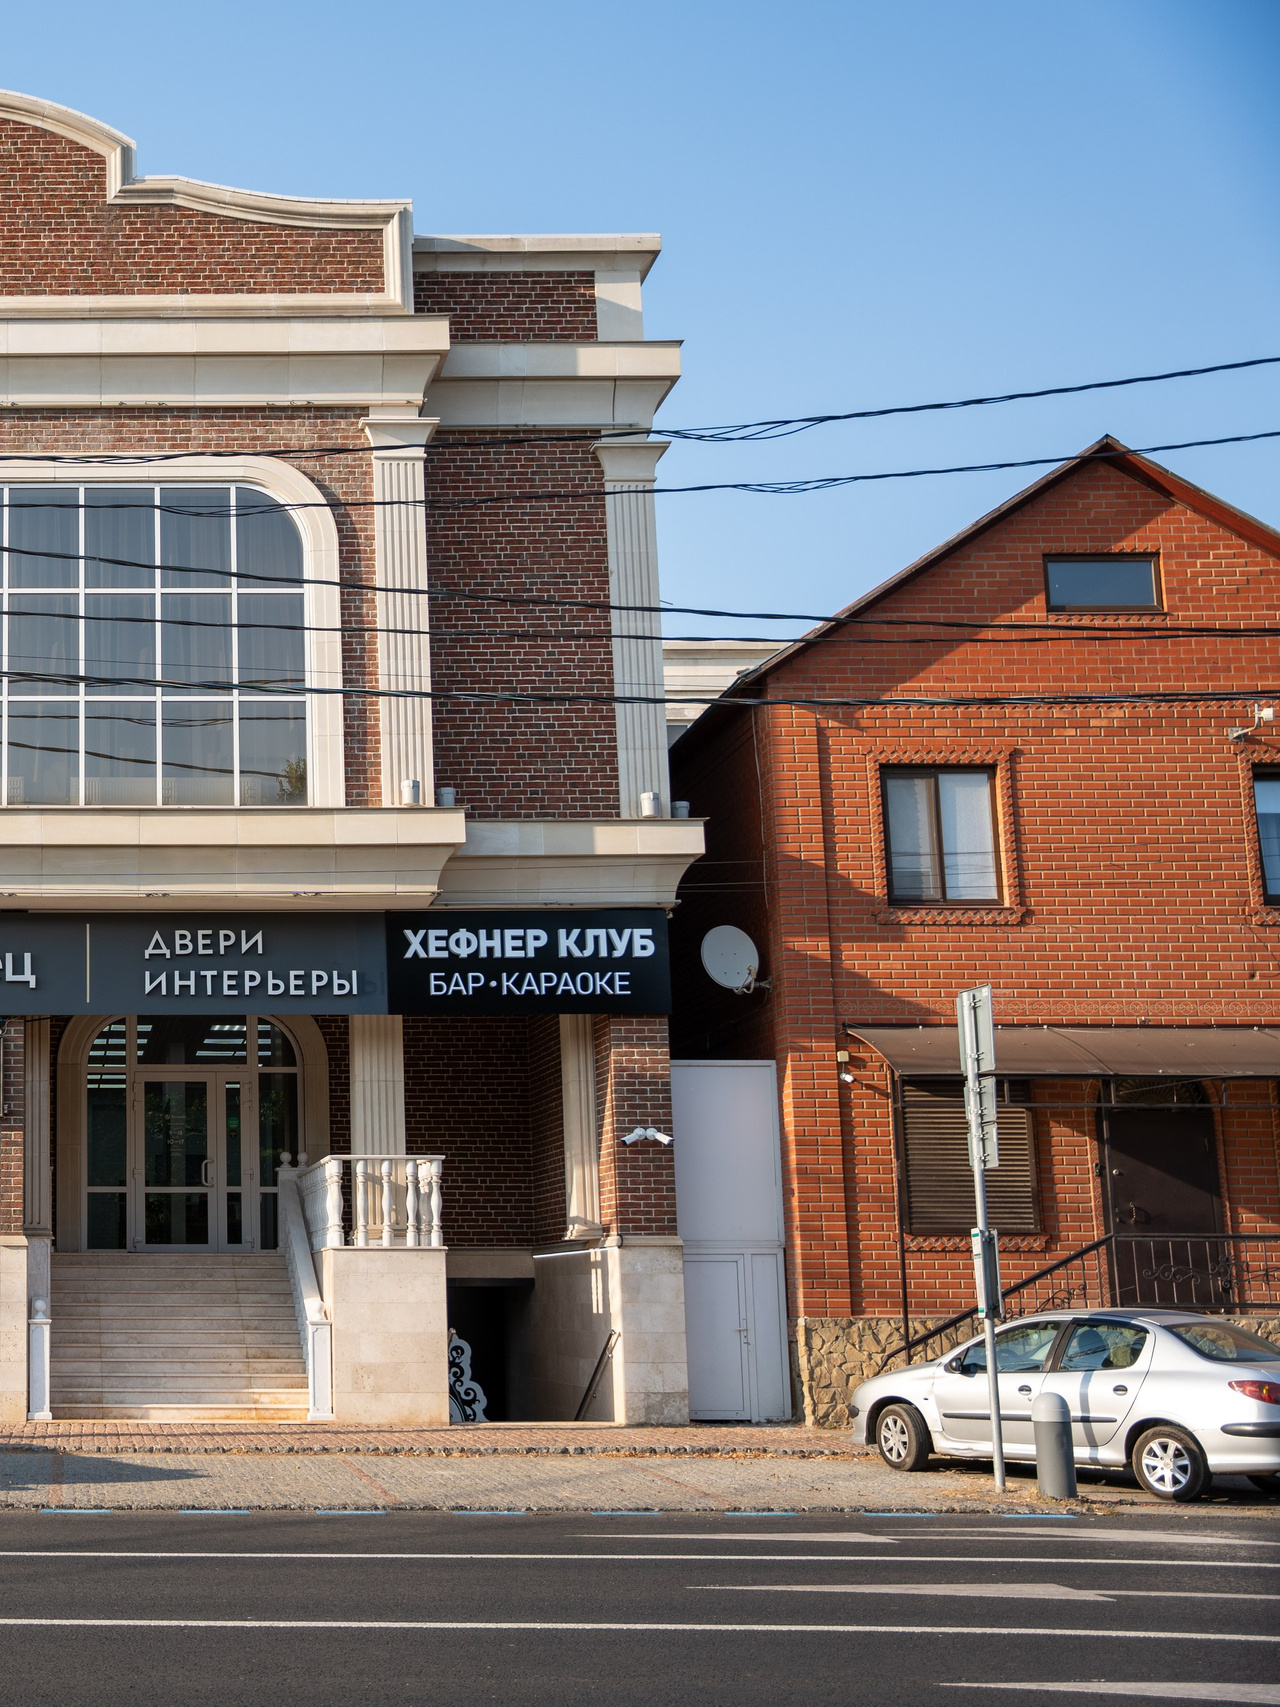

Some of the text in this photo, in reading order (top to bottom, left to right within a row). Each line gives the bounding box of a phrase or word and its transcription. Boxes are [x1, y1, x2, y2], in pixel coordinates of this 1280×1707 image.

[144, 929, 264, 960] ДВЕРИ
[402, 928, 656, 959] ХЕФНЕР КЛУБ
[144, 969, 358, 996] ИНТЕРЬЕРЫ
